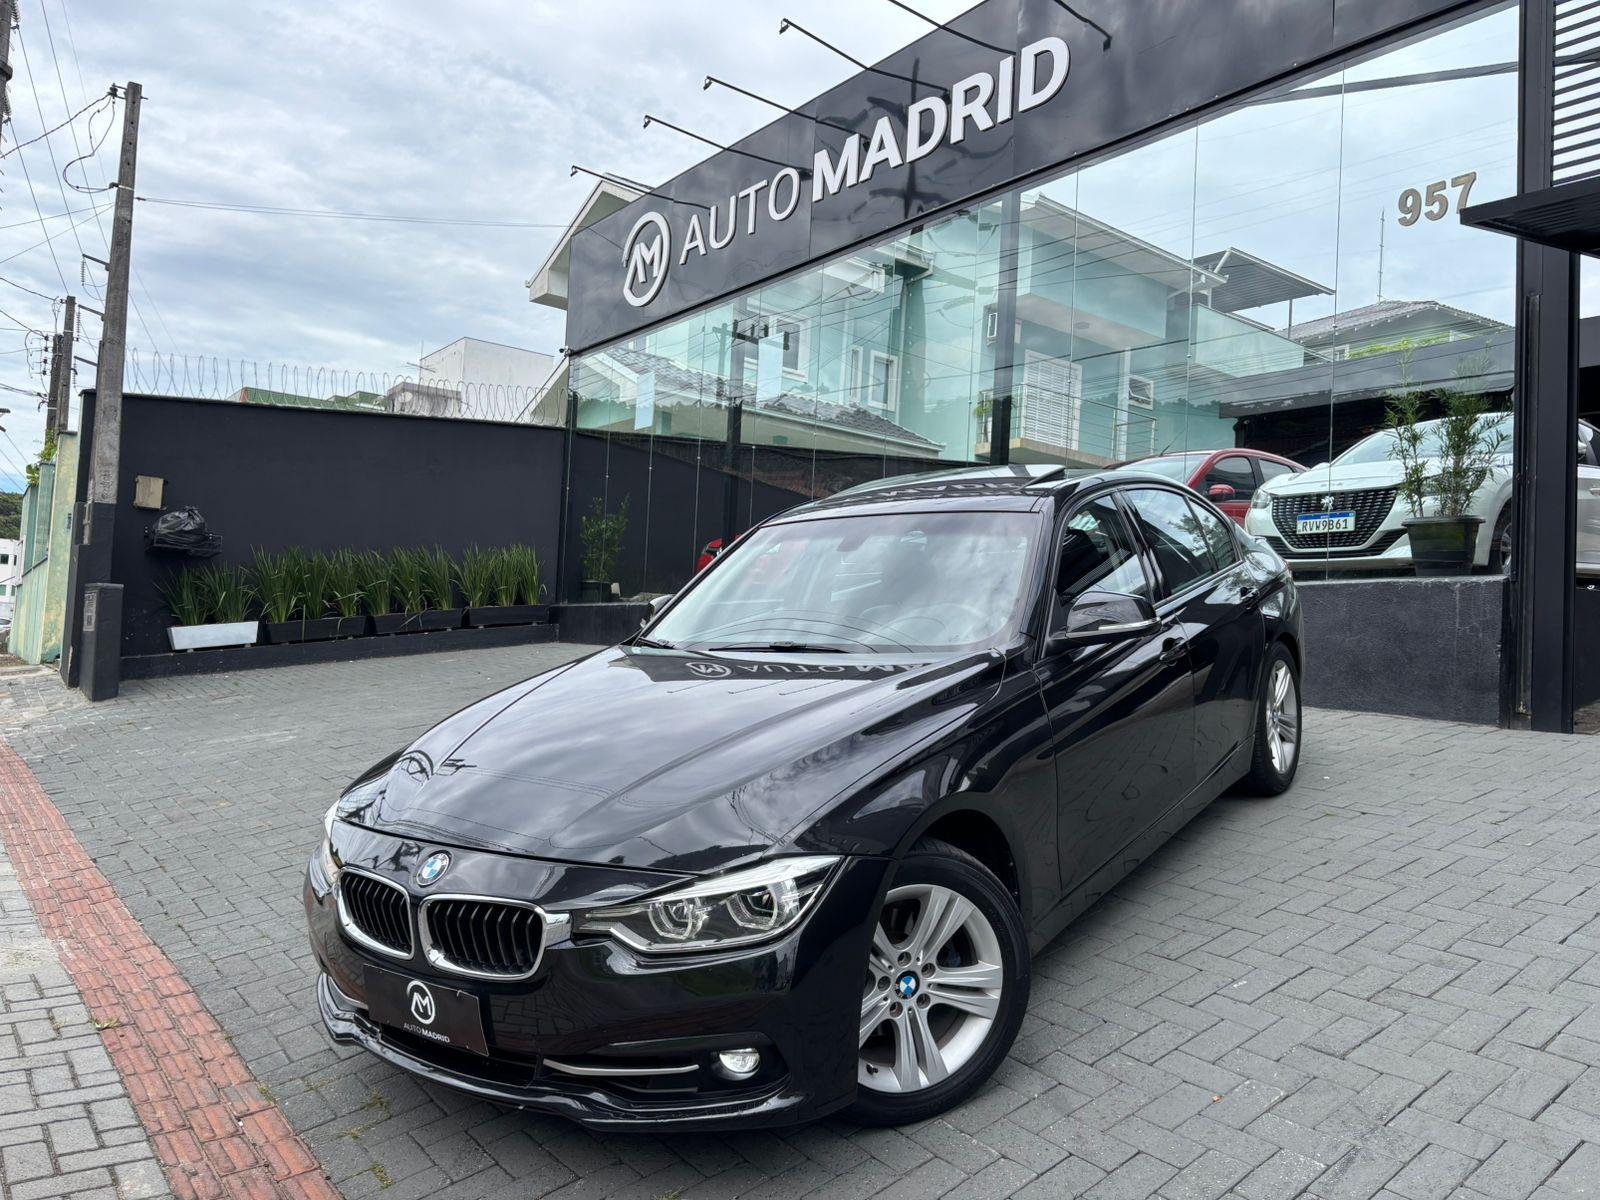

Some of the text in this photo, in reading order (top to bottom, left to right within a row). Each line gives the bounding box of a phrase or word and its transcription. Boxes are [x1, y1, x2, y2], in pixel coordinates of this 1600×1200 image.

[679, 36, 1071, 266] AUTO MADRID
[1397, 171, 1477, 227] 957
[403, 1022, 451, 1043] AUTO MADRID
